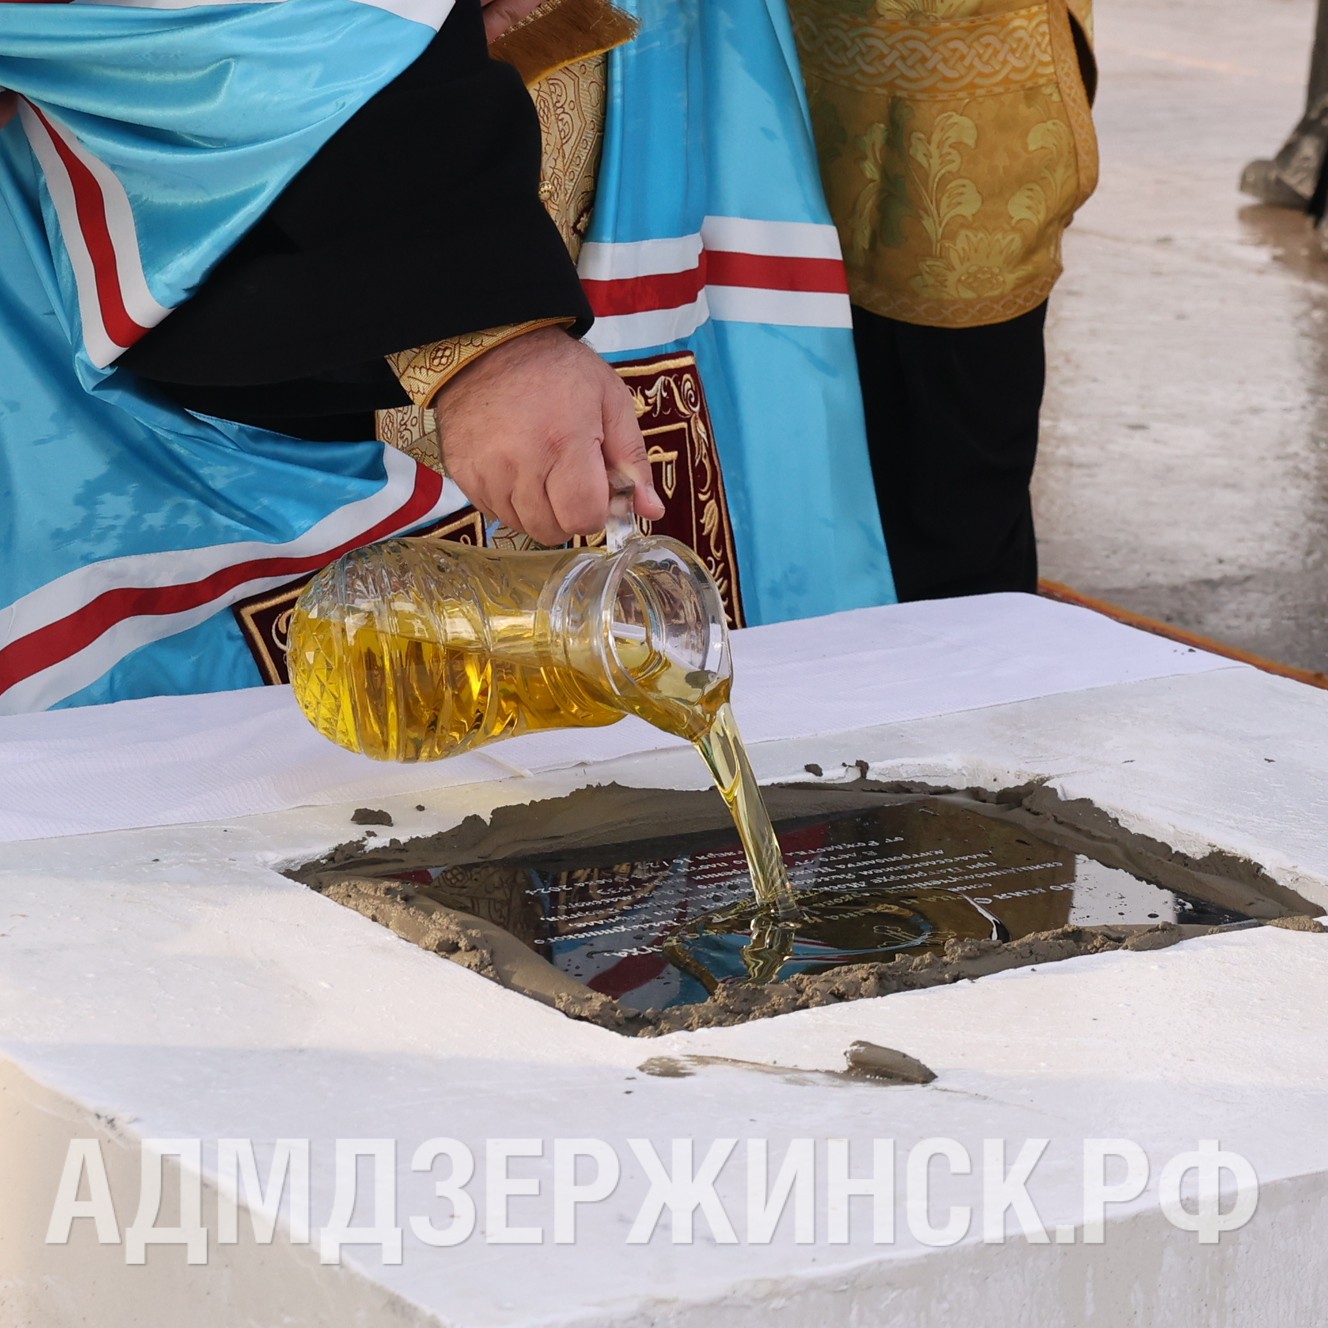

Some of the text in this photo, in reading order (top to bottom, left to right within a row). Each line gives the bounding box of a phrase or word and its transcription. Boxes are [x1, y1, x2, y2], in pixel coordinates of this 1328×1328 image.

[885, 835, 905, 844] от
[967, 861, 997, 871] при
[871, 865, 965, 884] Патриархе
[993, 890, 1046, 902] имя
